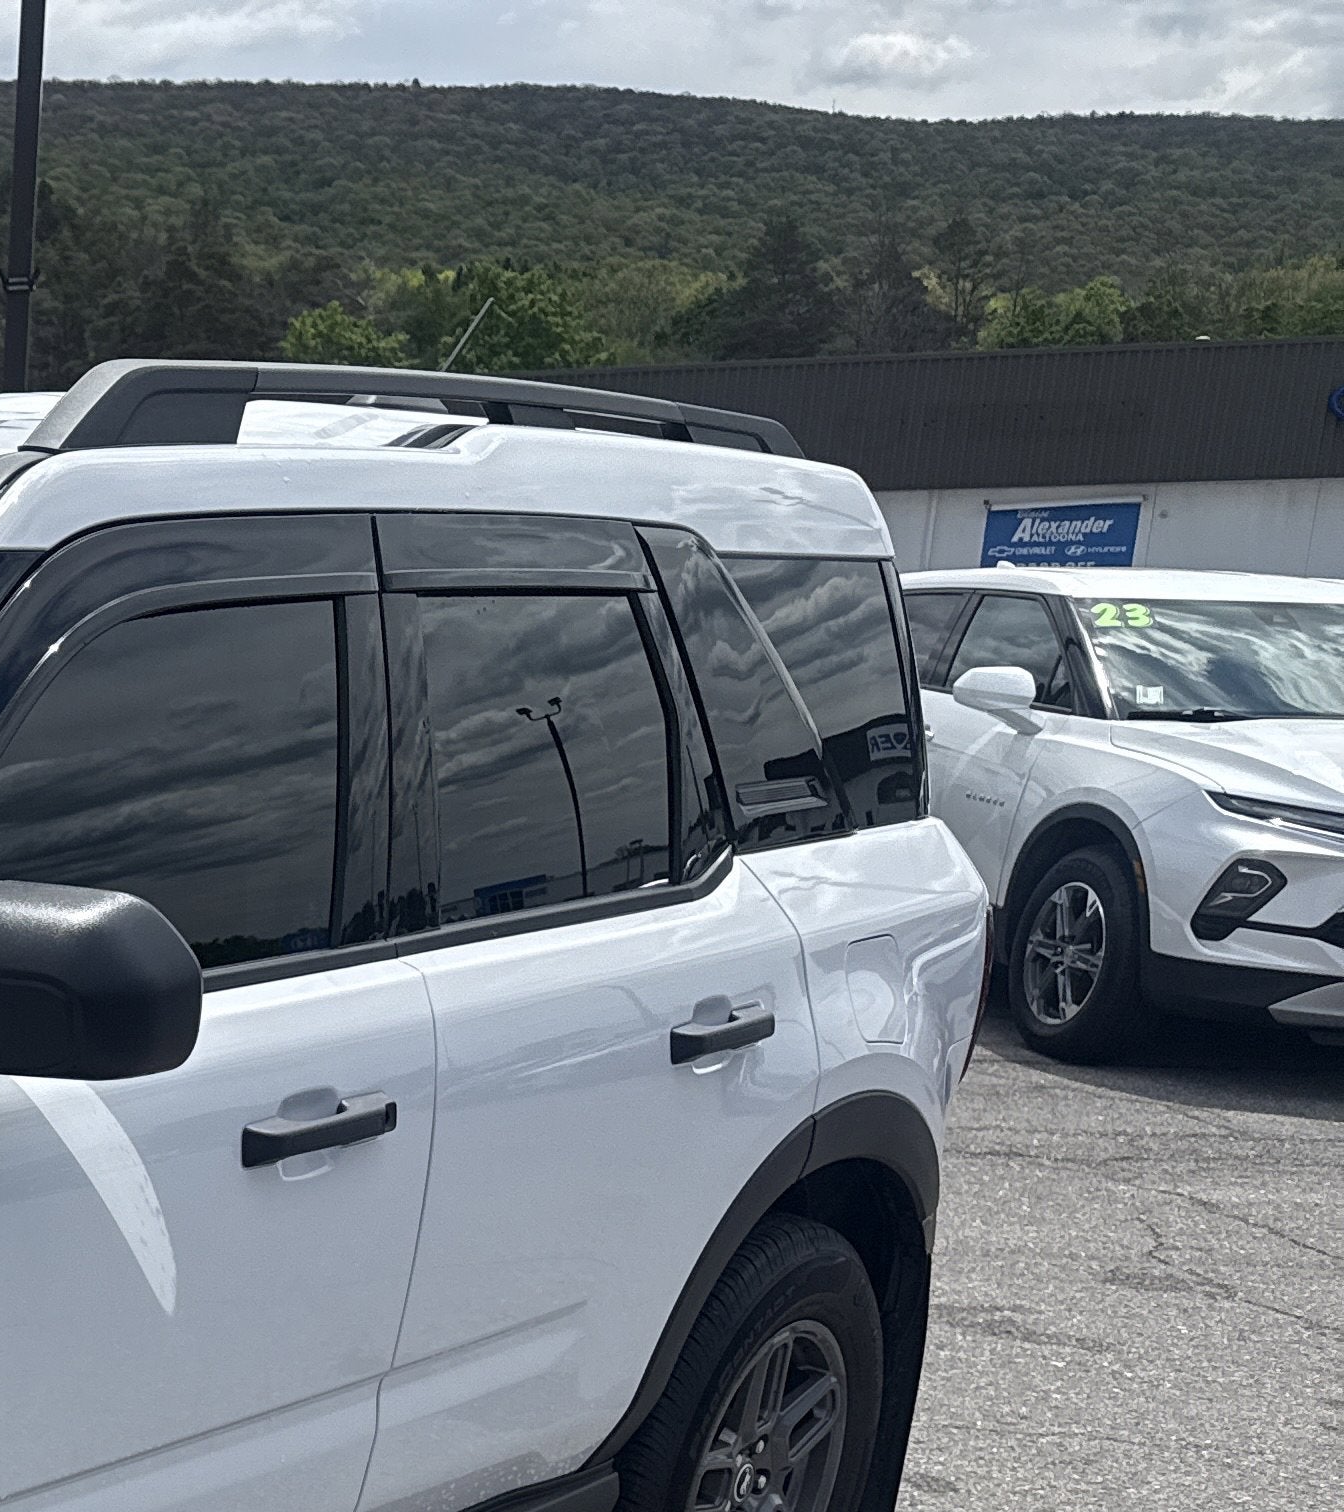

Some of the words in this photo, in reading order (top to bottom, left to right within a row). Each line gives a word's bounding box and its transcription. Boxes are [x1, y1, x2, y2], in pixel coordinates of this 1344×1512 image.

[1010, 516, 1114, 542] Alexander
[1031, 532, 1085, 542] ALTOONA
[1090, 602, 1154, 628] 23
